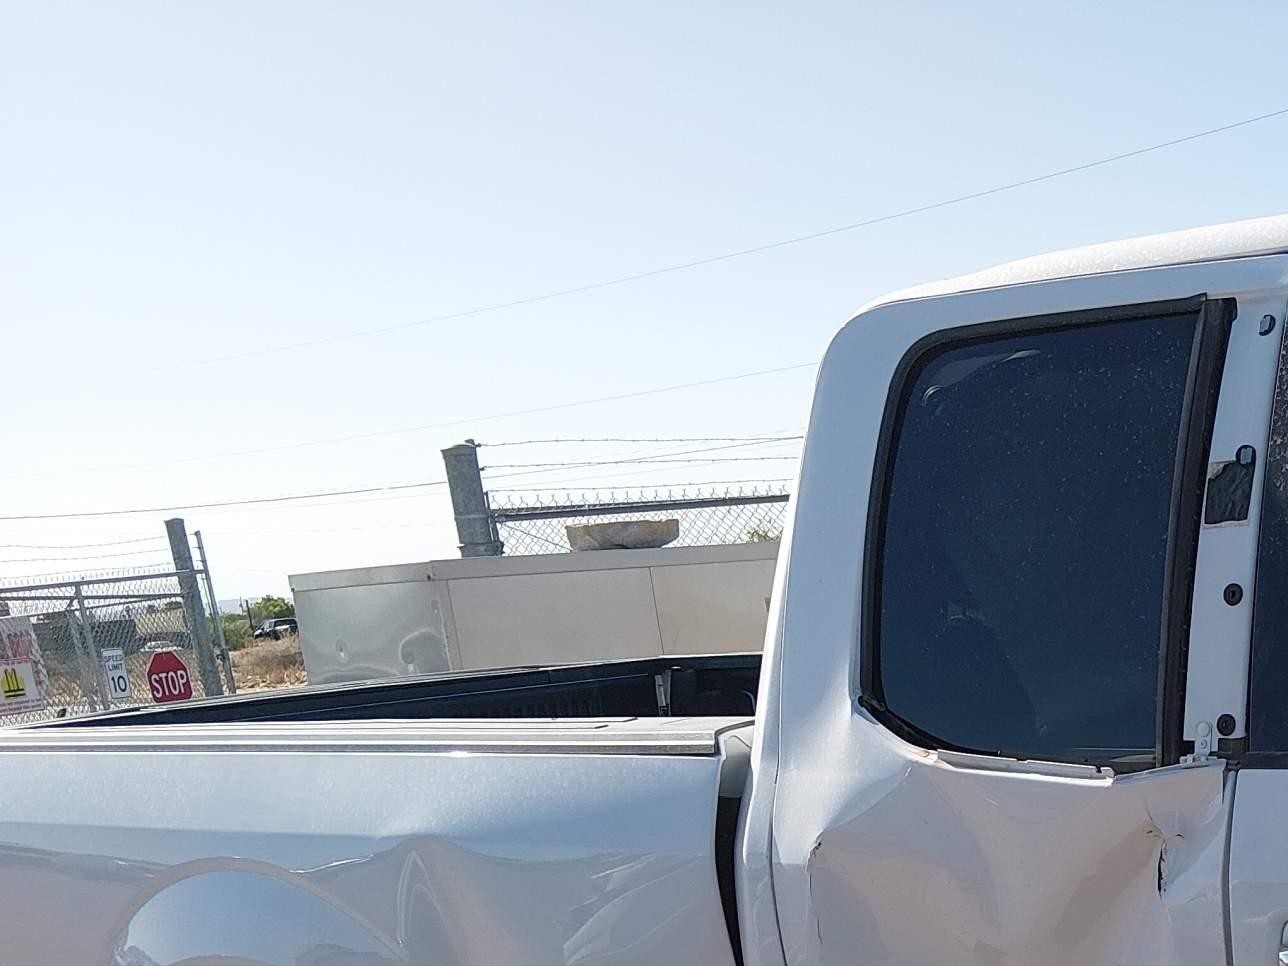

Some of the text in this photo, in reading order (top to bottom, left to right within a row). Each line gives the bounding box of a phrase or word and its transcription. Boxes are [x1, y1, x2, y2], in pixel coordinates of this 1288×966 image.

[104, 654, 123, 663] SPEED
[107, 663, 123, 671] LIMIT
[111, 675, 127, 693] 10
[151, 670, 187, 698] STOP
